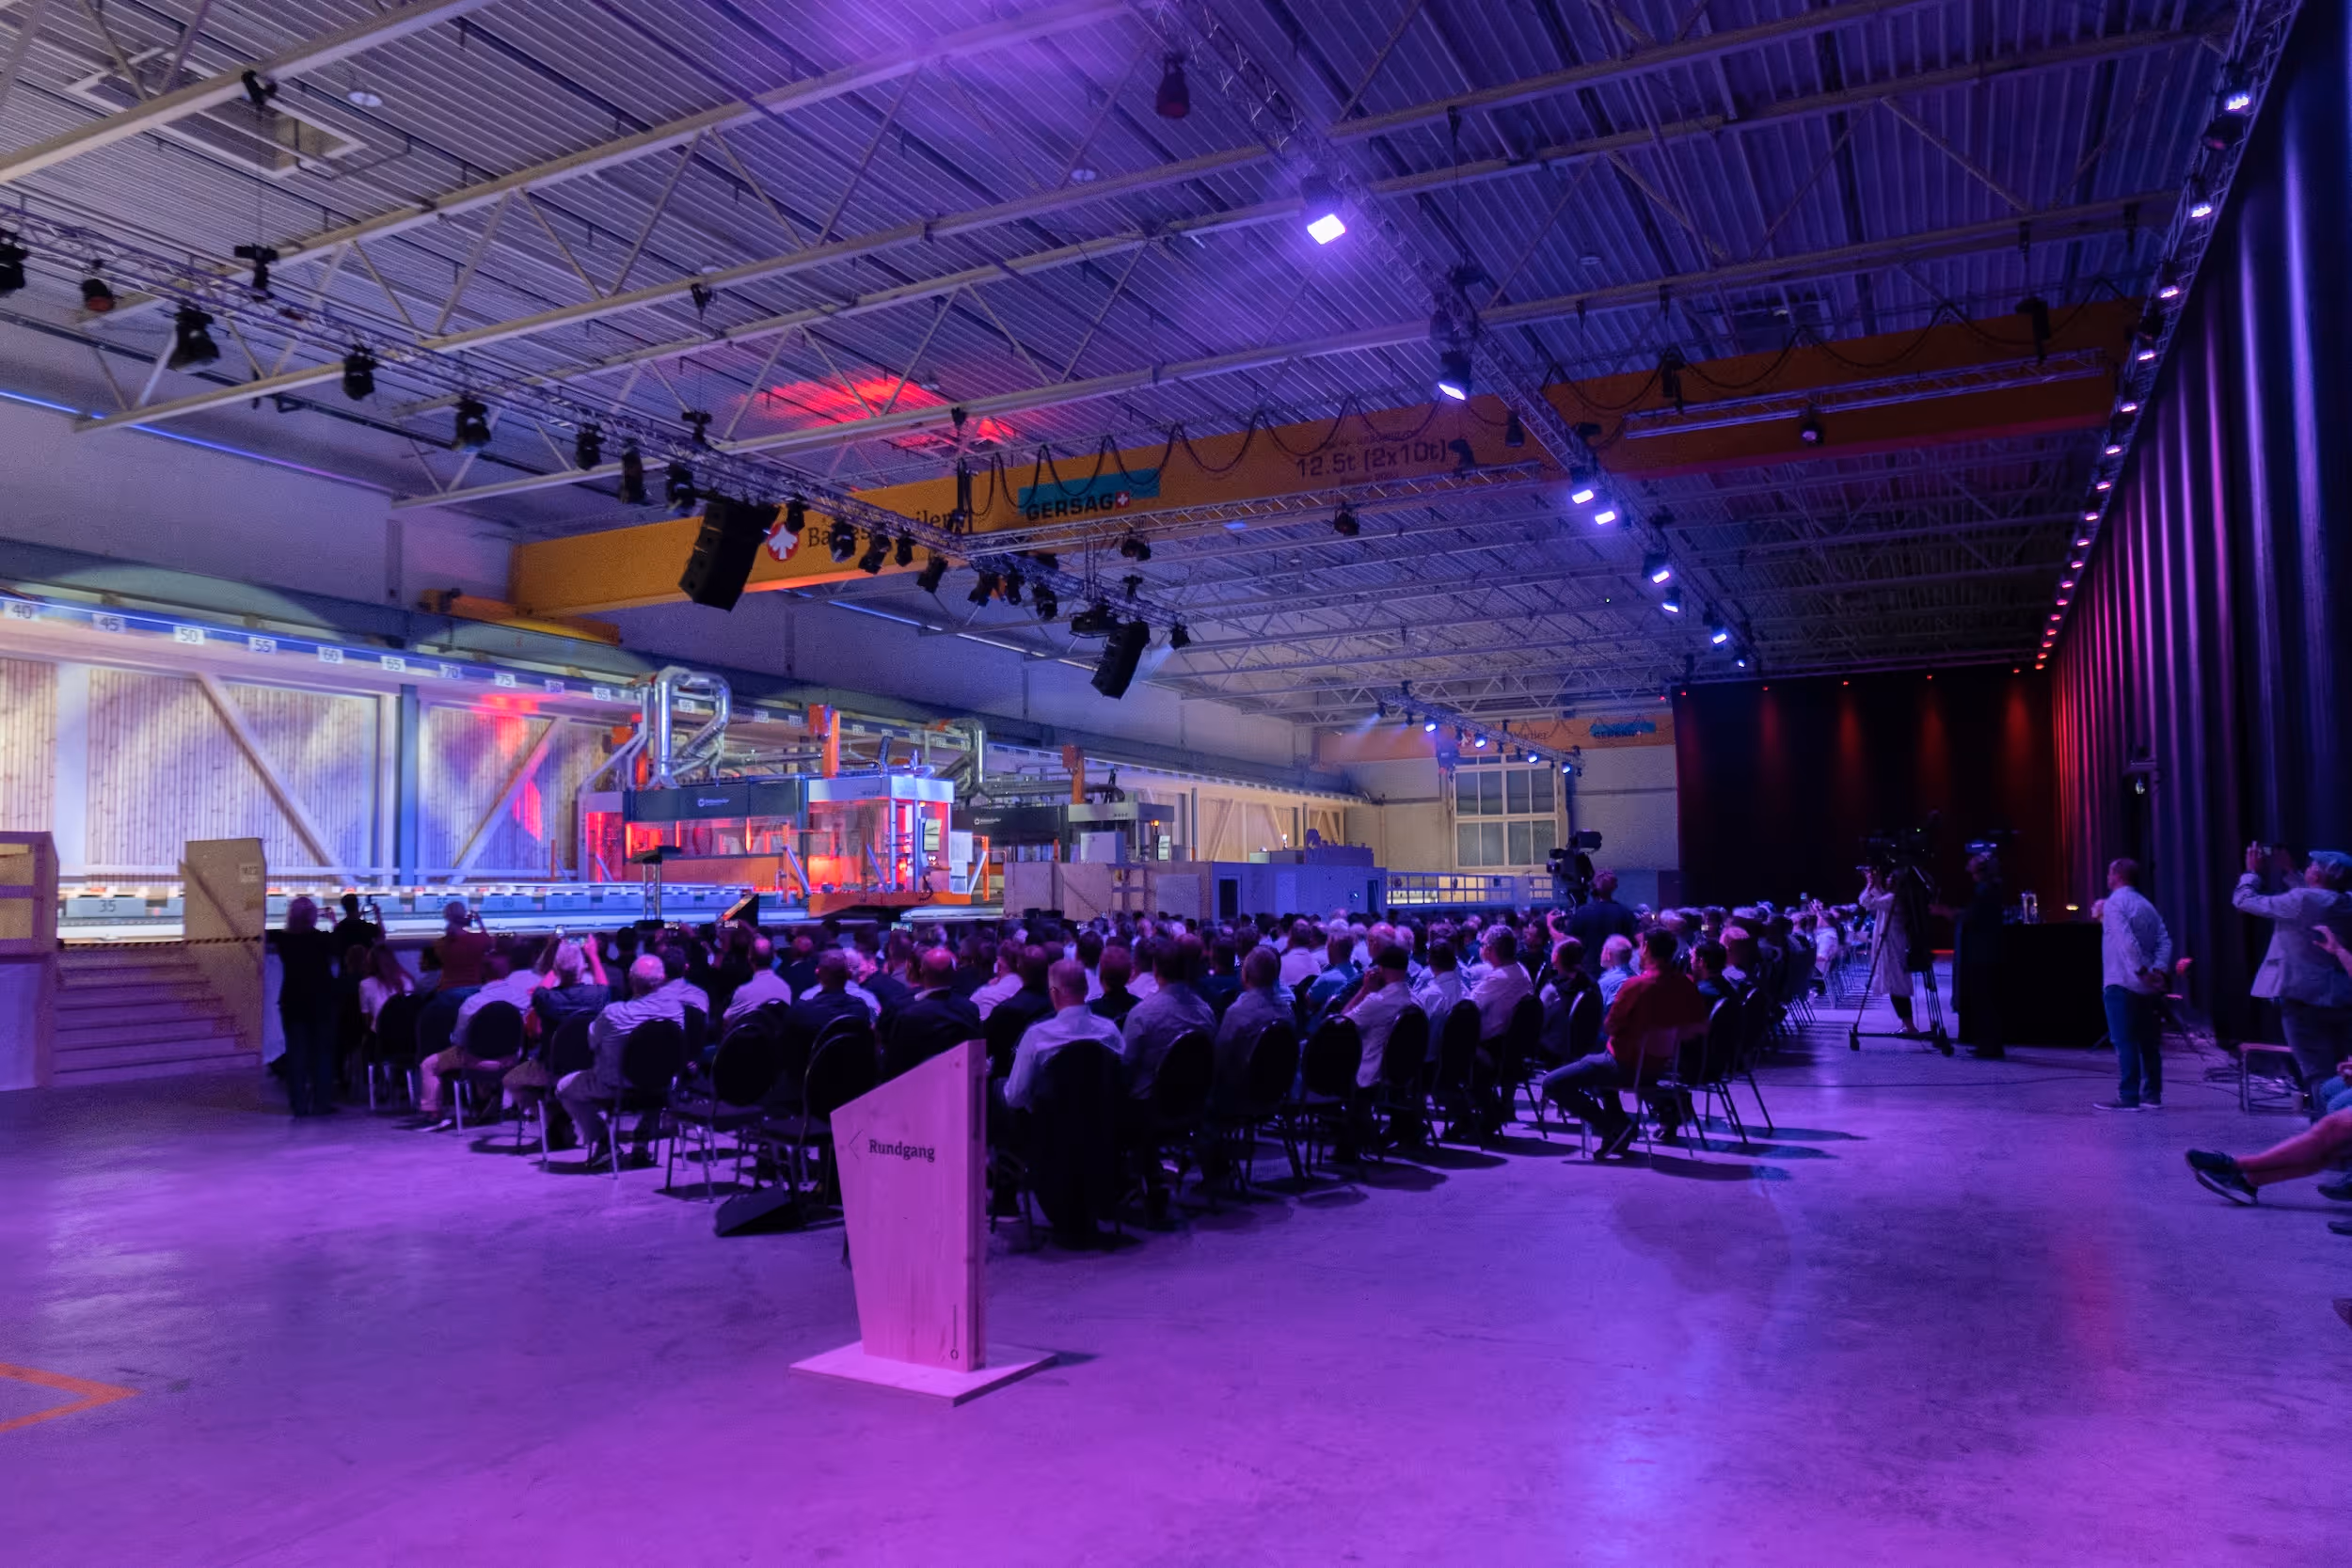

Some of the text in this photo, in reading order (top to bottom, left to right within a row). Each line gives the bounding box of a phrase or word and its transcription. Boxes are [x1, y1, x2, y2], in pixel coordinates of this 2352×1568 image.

[1296, 453, 1356, 478] 12.5t
[1025, 493, 1113, 521] GERSAG
[11, 603, 31, 620] 40
[99, 616, 119, 632] 45
[181, 627, 199, 643] 50
[255, 639, 271, 653] 55
[323, 649, 339, 662] 60
[386, 657, 401, 671] 65
[444, 666, 459, 679] 70
[499, 674, 513, 687] 75
[98, 899, 116, 912] 35
[868, 1139, 935, 1163] Rundgang
